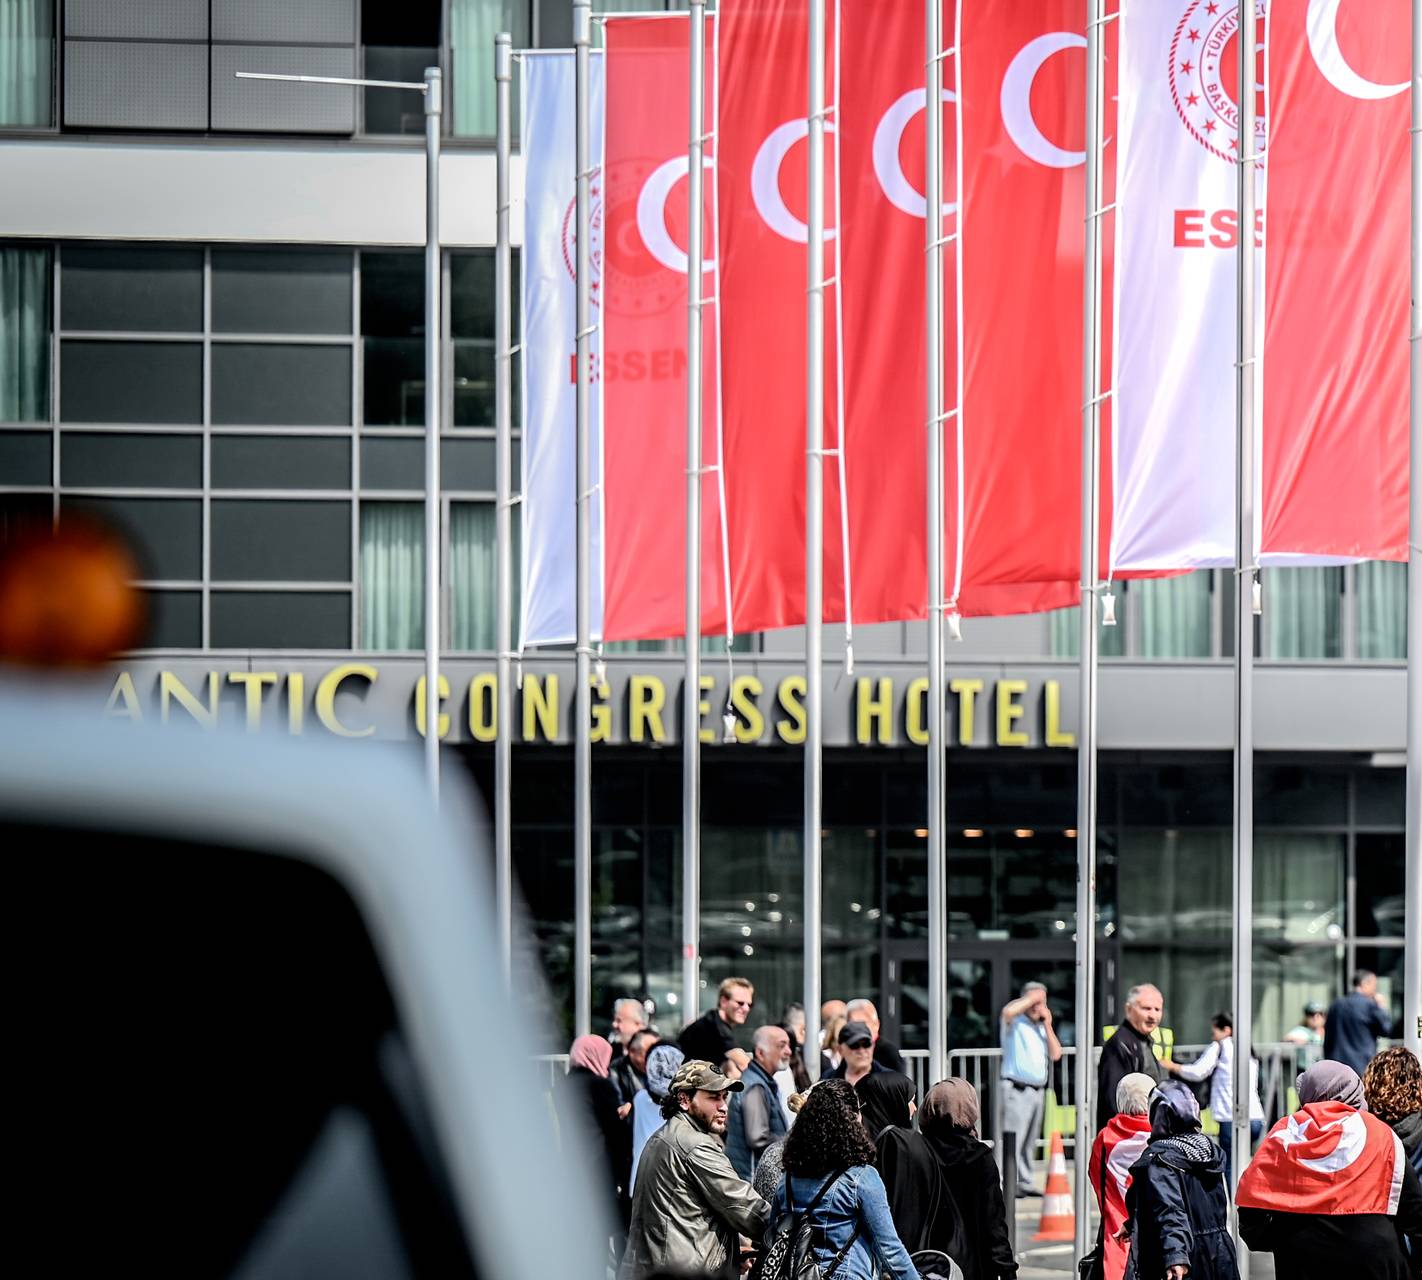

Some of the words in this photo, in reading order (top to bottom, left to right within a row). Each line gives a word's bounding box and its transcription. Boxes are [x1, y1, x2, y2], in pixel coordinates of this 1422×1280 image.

[104, 662, 378, 738] ANTIC
[415, 673, 807, 744] CONGRESS
[857, 676, 1075, 747] HOTEL
